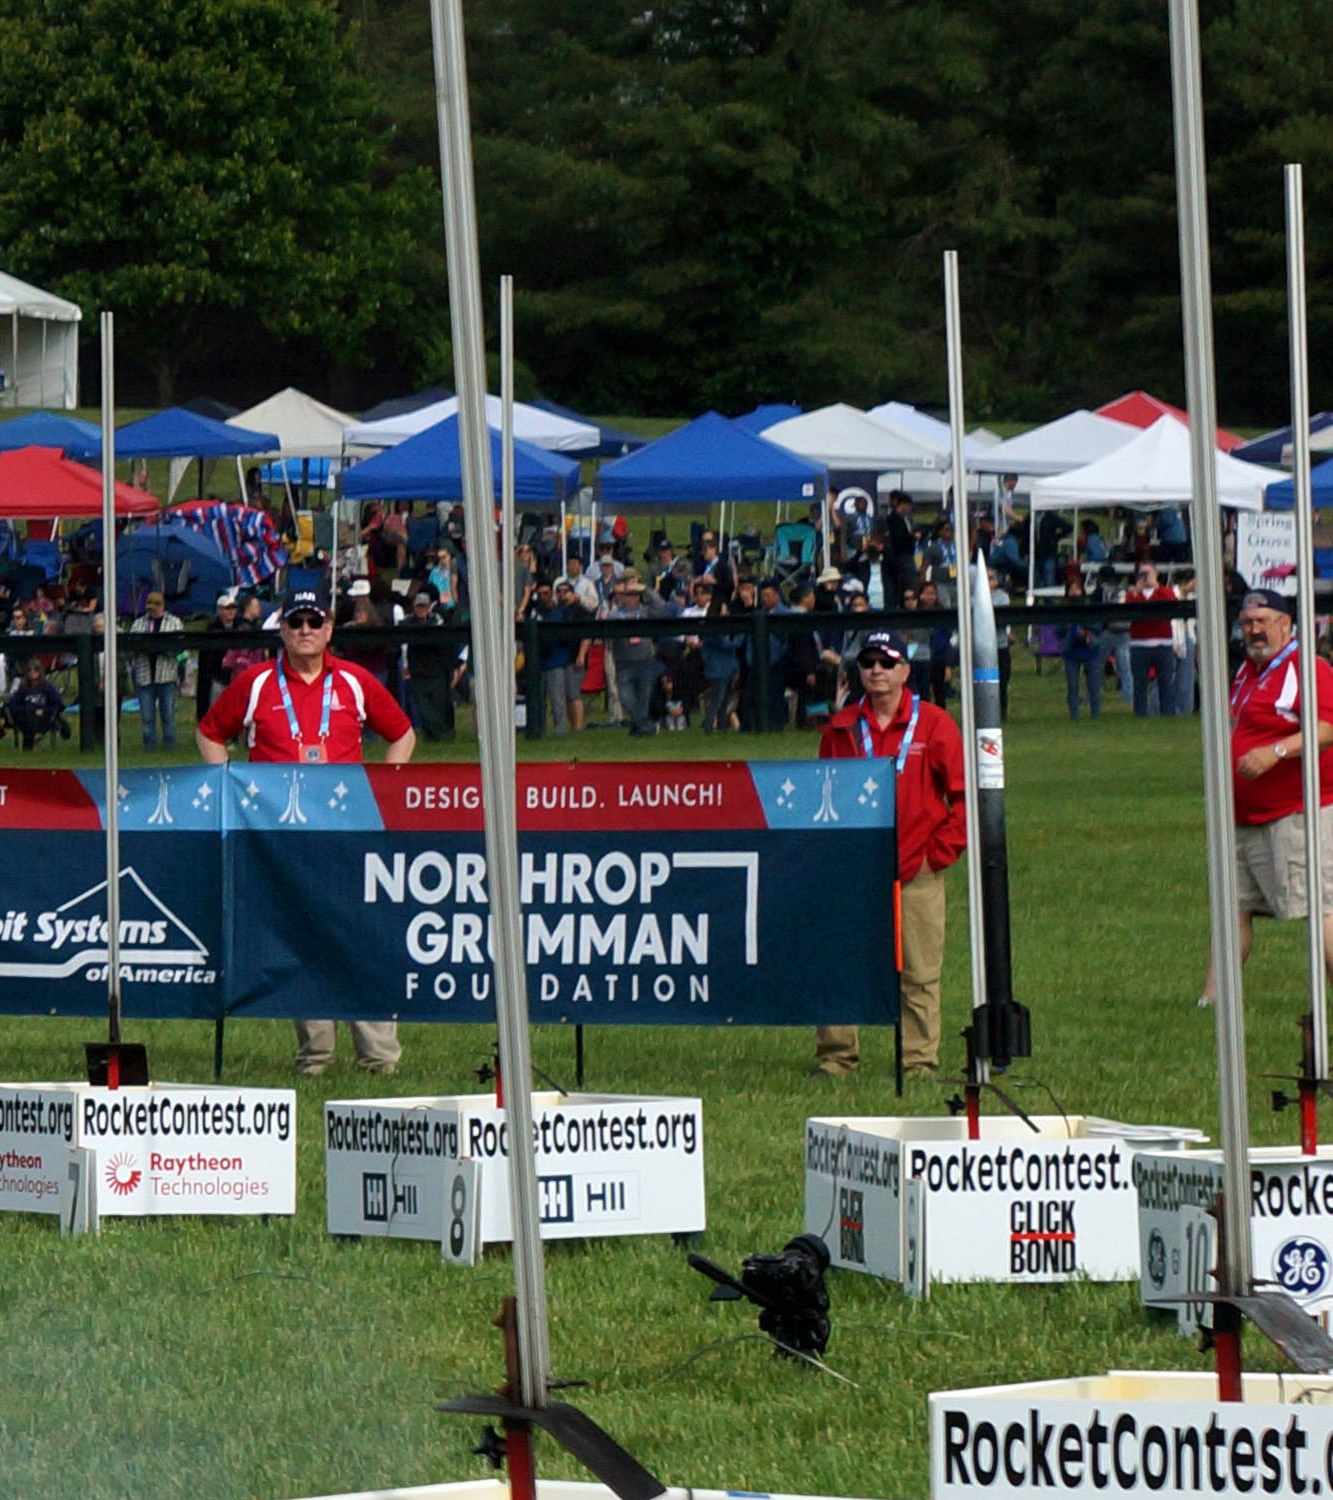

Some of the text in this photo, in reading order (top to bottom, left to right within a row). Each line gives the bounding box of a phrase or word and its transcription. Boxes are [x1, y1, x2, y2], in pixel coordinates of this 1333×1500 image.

[526, 785, 606, 809] BUILD.
[618, 783, 724, 807] LAUNCH!
[363, 850, 672, 906] NORHROP
[117, 964, 216, 984] America
[406, 972, 710, 1003] FOUDATION
[84, 1095, 291, 1142] RocketContest.org
[327, 1110, 458, 1160] RocketContest.org
[150, 1152, 243, 1176] Raytheon
[151, 1176, 270, 1201] Technologies
[586, 1181, 626, 1213] HII
[450, 1173, 466, 1257] 8
[1010, 1201, 1076, 1234] CLICK
[1010, 1240, 1076, 1274] BOND
